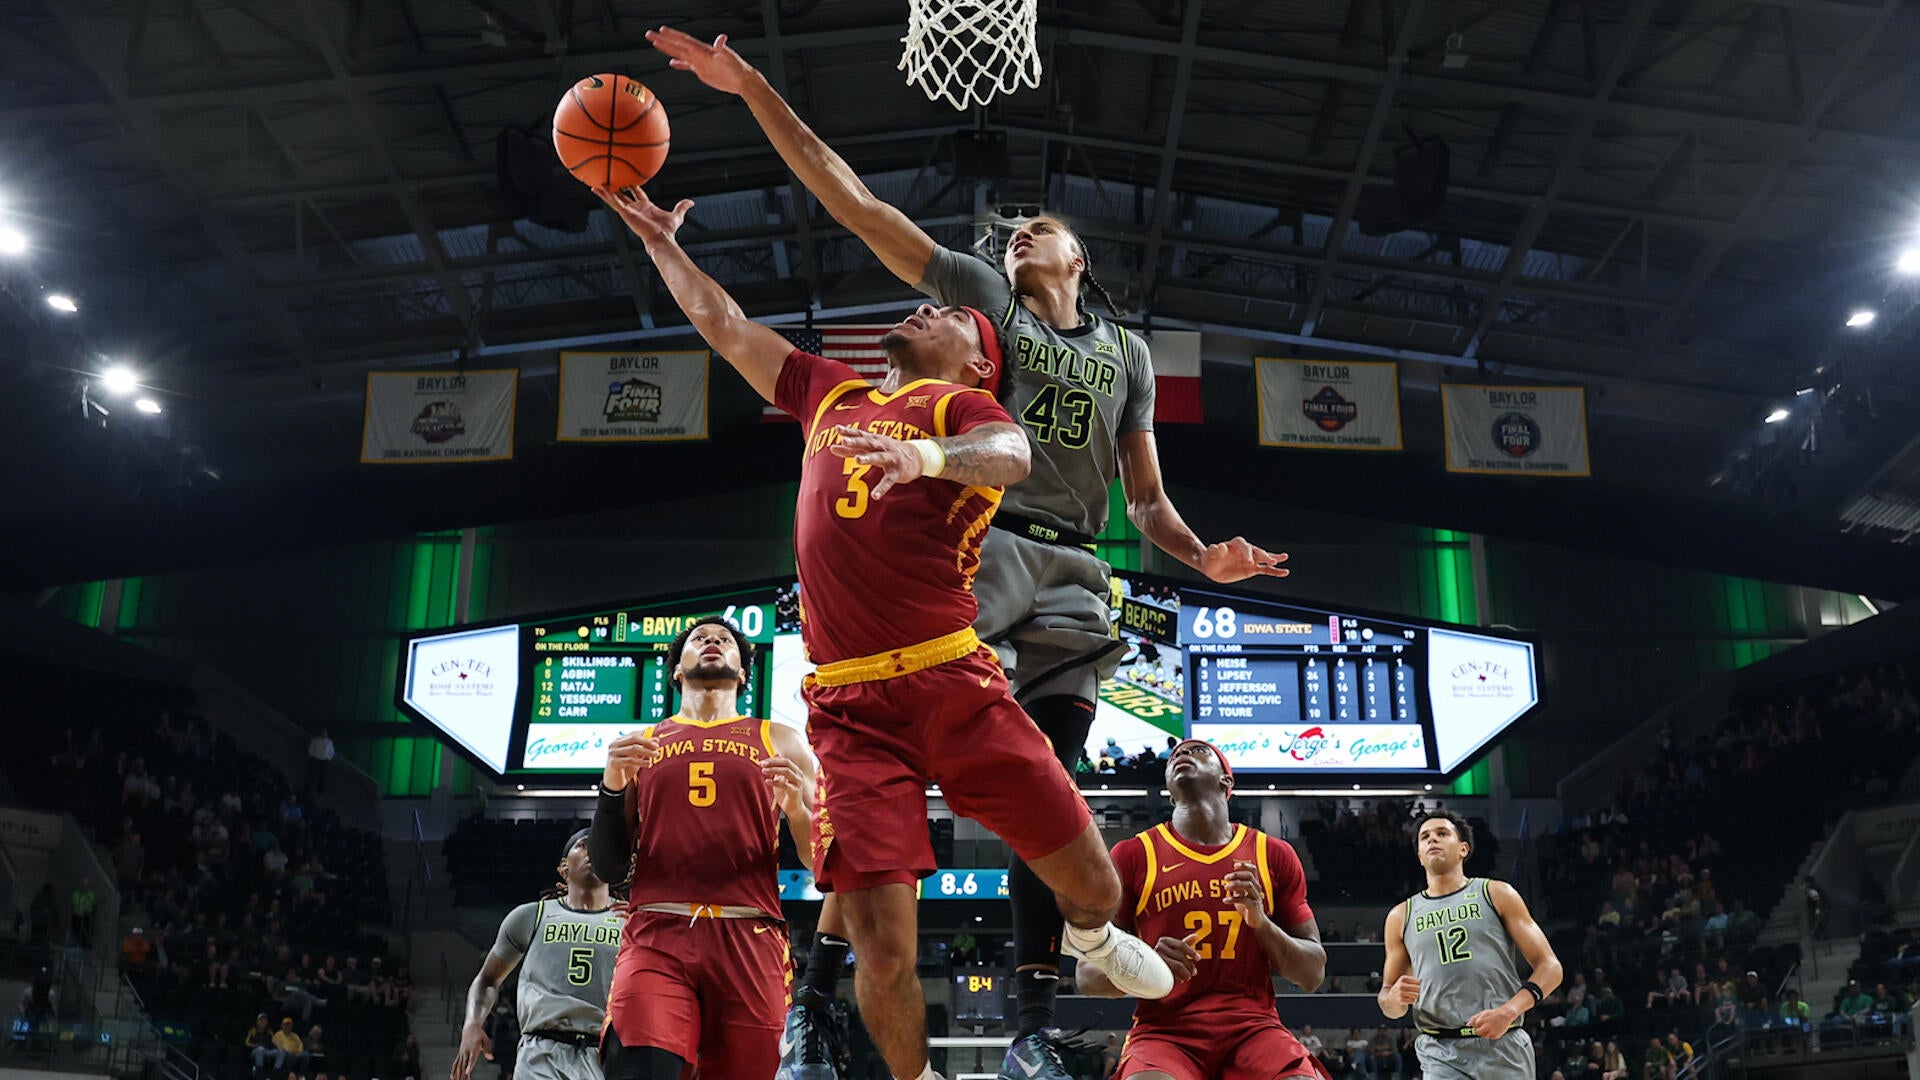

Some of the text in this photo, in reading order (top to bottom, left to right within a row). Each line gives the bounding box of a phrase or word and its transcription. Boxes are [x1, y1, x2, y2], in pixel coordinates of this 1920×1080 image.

[609, 357, 660, 370] BAYLOR
[1016, 333, 1118, 397] BAYLOR
[1303, 365, 1350, 379] BAYLOR
[416, 377, 467, 391] BAYLOR
[621, 384, 660, 398] FINAL
[1489, 391, 1537, 404] BAYLOR
[606, 393, 660, 414] FOUR
[1304, 402, 1355, 415] FINAL FOUR
[1020, 383, 1095, 449] 43
[599, 428, 636, 437] NATIONAL
[639, 427, 686, 436] CHAMPIONS
[1501, 424, 1530, 434] FINAL
[1299, 434, 1336, 443] NATIONAL
[1337, 436, 1381, 445] CHAMPIONS
[1503, 436, 1531, 446] FOUR
[404, 448, 441, 457] NATIONAL
[444, 447, 491, 457] CHAMPIONS
[1486, 460, 1521, 470] NATIONAL
[835, 457, 872, 519] 3
[594, 617, 609, 625] FLS
[1193, 606, 1237, 638] 68
[1342, 619, 1357, 628] FLS
[595, 627, 607, 637] 10
[1243, 624, 1312, 634] IOWA STATE
[1345, 630, 1357, 640] 10
[535, 642, 669, 651] ON THE FLOOR PTS
[1189, 645, 1403, 653] ON THE FLOOR PTS REB AST PF
[431, 658, 494, 678] CEN-TEX
[545, 657, 664, 667] 0 SKILLINGS JR. 3
[1200, 657, 1403, 668] 0 HEISE 6 6 1 1
[544, 670, 551, 679] 5
[561, 669, 596, 679] AGBIM
[1201, 670, 1404, 680] 3 LIPSEY 24 3 2 3
[1450, 661, 1511, 680] CEN-TEX
[541, 682, 662, 692] 12 RATAJ 8
[1201, 682, 1405, 693] 5 JEFFERSON 19 16 3 4
[540, 694, 753, 704] 24 YESSOUFOU 10 3
[1199, 694, 1406, 705] 22 MOMCILOVIC 4 3 1 4
[538, 707, 551, 716] 43
[558, 707, 588, 717] CARR
[651, 708, 663, 717] 17
[1199, 706, 1407, 718] 27 TOURE 10 4 3 3
[528, 731, 603, 761] George's
[702, 738, 761, 766] STATE
[1279, 731, 1340, 760] Jorge's
[1349, 732, 1421, 762] George's
[688, 761, 717, 807] 5
[940, 872, 978, 895] 8.6
[1155, 880, 1203, 912] IOWA
[1415, 903, 1482, 935] BAYLOR
[543, 922, 621, 947] BAYLOR
[1184, 911, 1243, 960] 27
[1435, 925, 1473, 965] 12
[567, 947, 595, 986] 5
